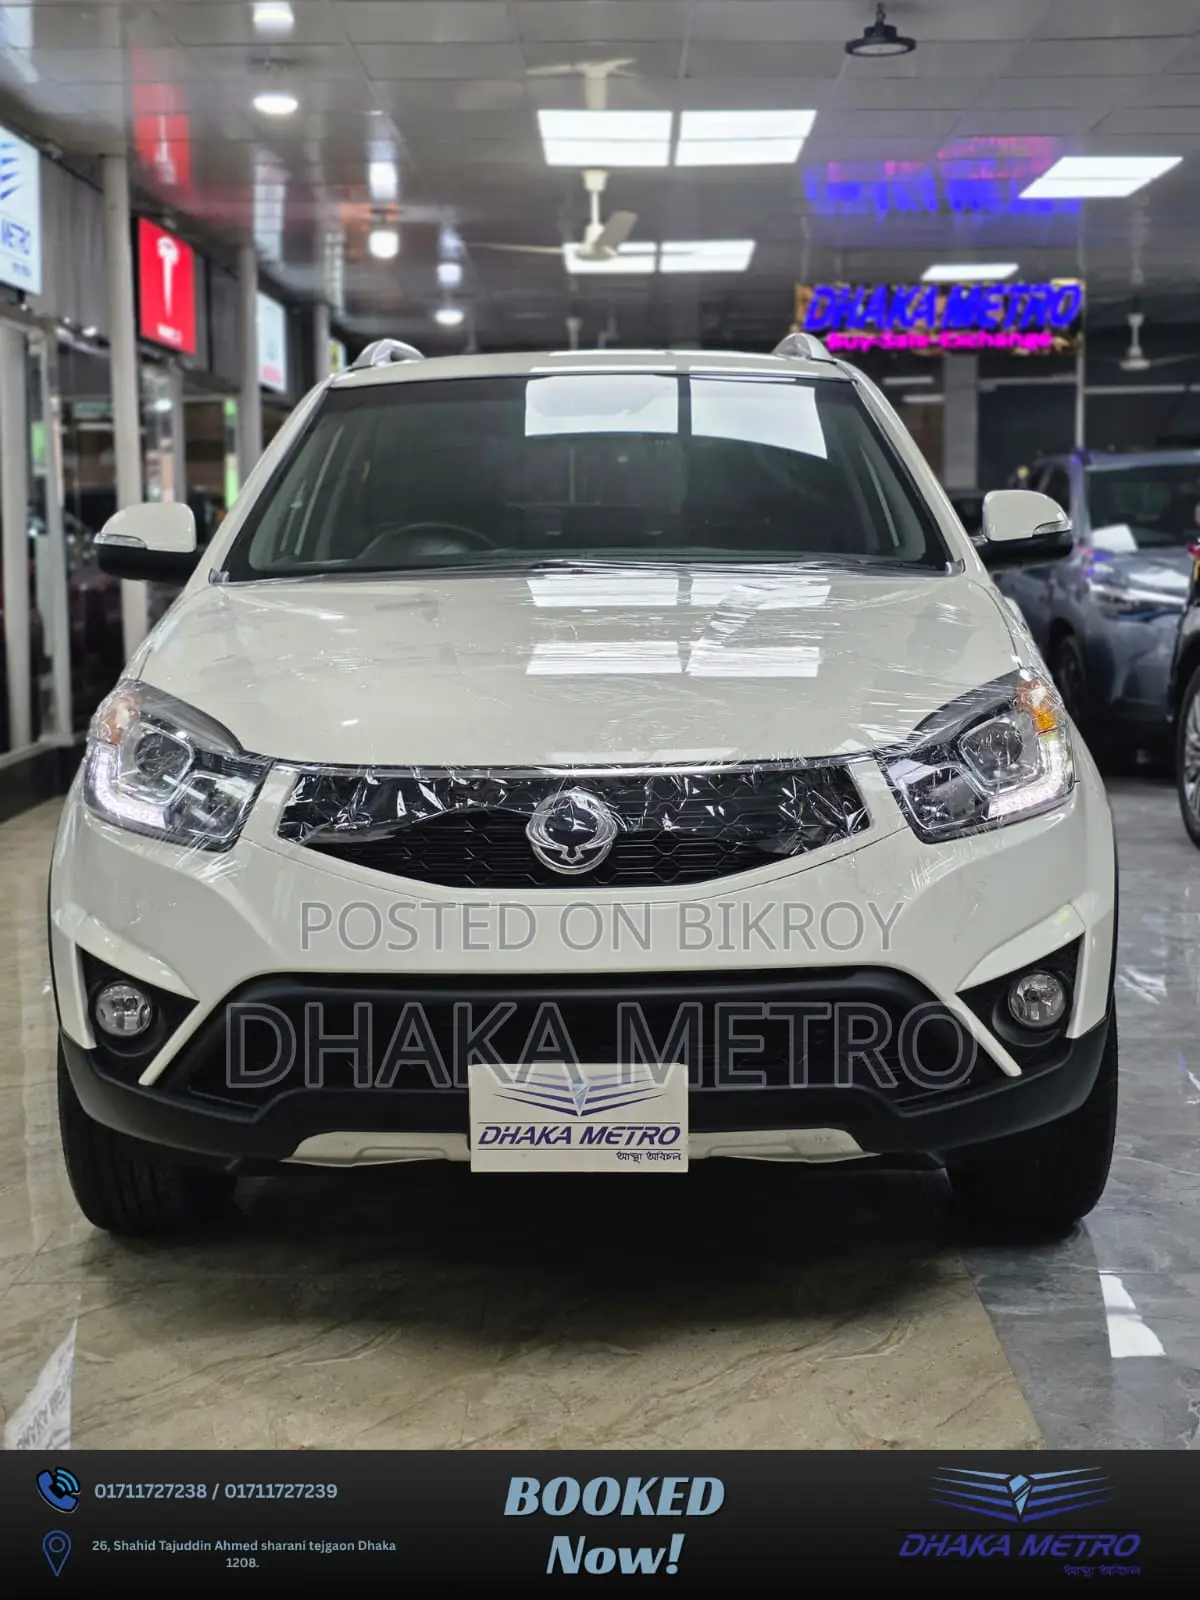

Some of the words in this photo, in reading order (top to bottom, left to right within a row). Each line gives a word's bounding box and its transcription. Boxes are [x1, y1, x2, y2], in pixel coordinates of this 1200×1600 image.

[804, 284, 938, 330] DHAKA
[943, 282, 1083, 330] METRO
[478, 1125, 573, 1146] DHAKA
[579, 1126, 680, 1146] METRO
